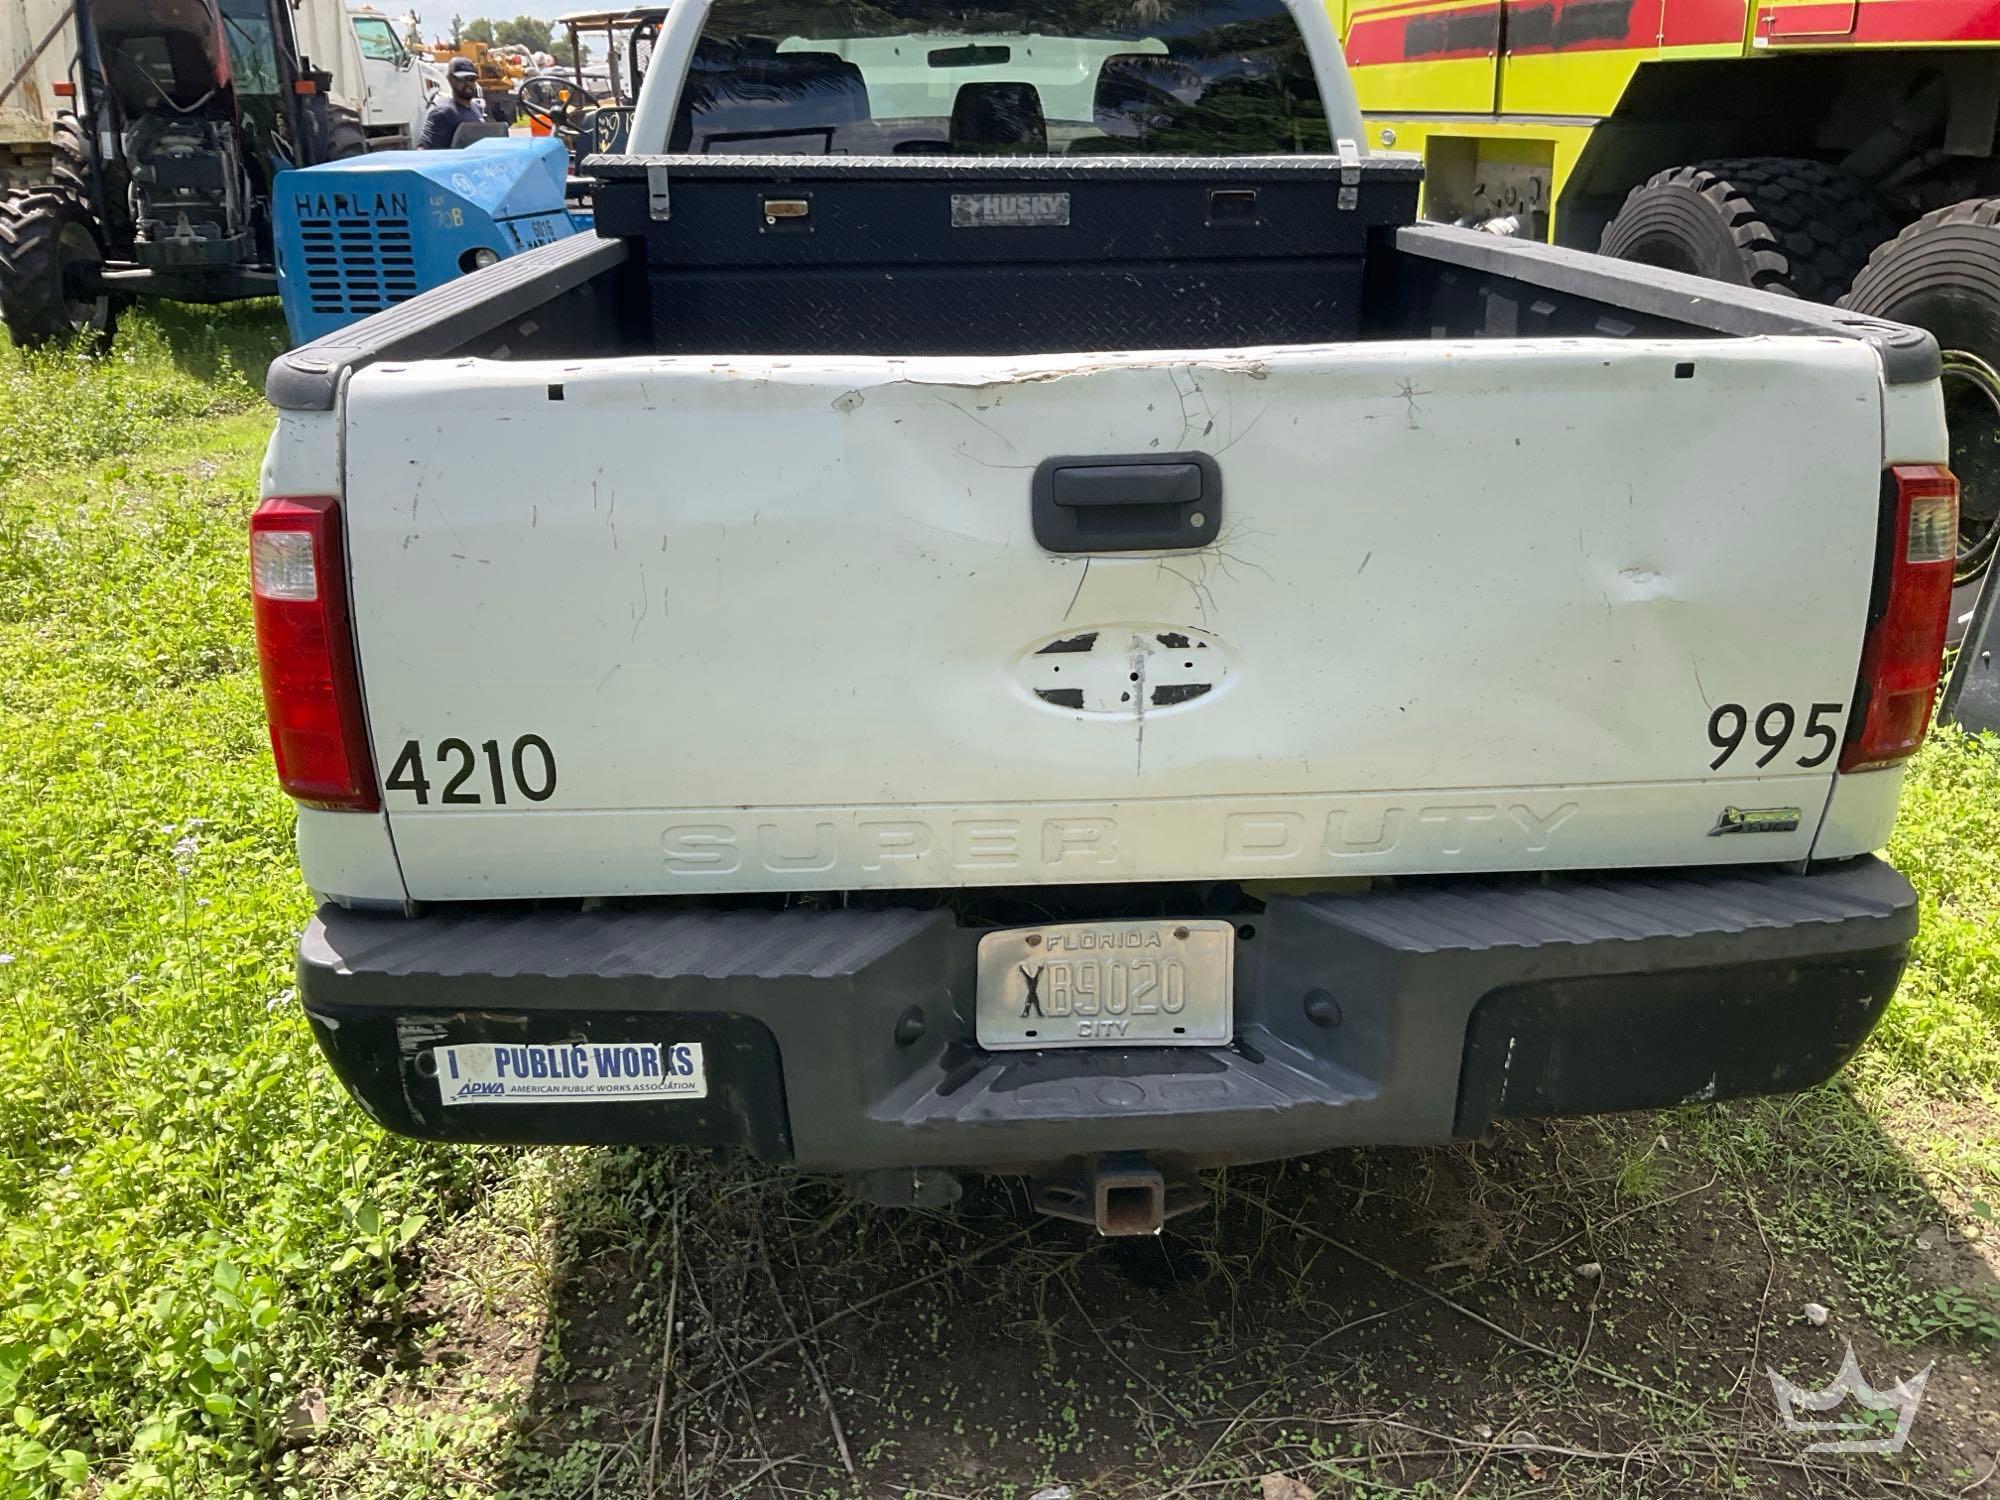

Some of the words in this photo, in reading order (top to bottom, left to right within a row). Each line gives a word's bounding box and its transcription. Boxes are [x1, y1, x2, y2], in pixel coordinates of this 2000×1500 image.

[295, 193, 408, 217] HARLAN
[983, 196, 1061, 214] HUSKY
[1707, 702, 1844, 771] 995
[385, 734, 557, 805] 4210
[661, 817, 1119, 876] SUPER
[1223, 802, 1580, 862] DUTY
[1046, 931, 1161, 950] FLORIDA
[1077, 1020, 1130, 1038] CITY
[447, 1050, 459, 1079] I
[495, 1047, 588, 1079] PUBLIC
[457, 1082, 505, 1095] APWA
[511, 1085, 559, 1093] AMERICAN
[562, 1085, 594, 1093] PUBLIC
[597, 1084, 631, 1092] WORKS
